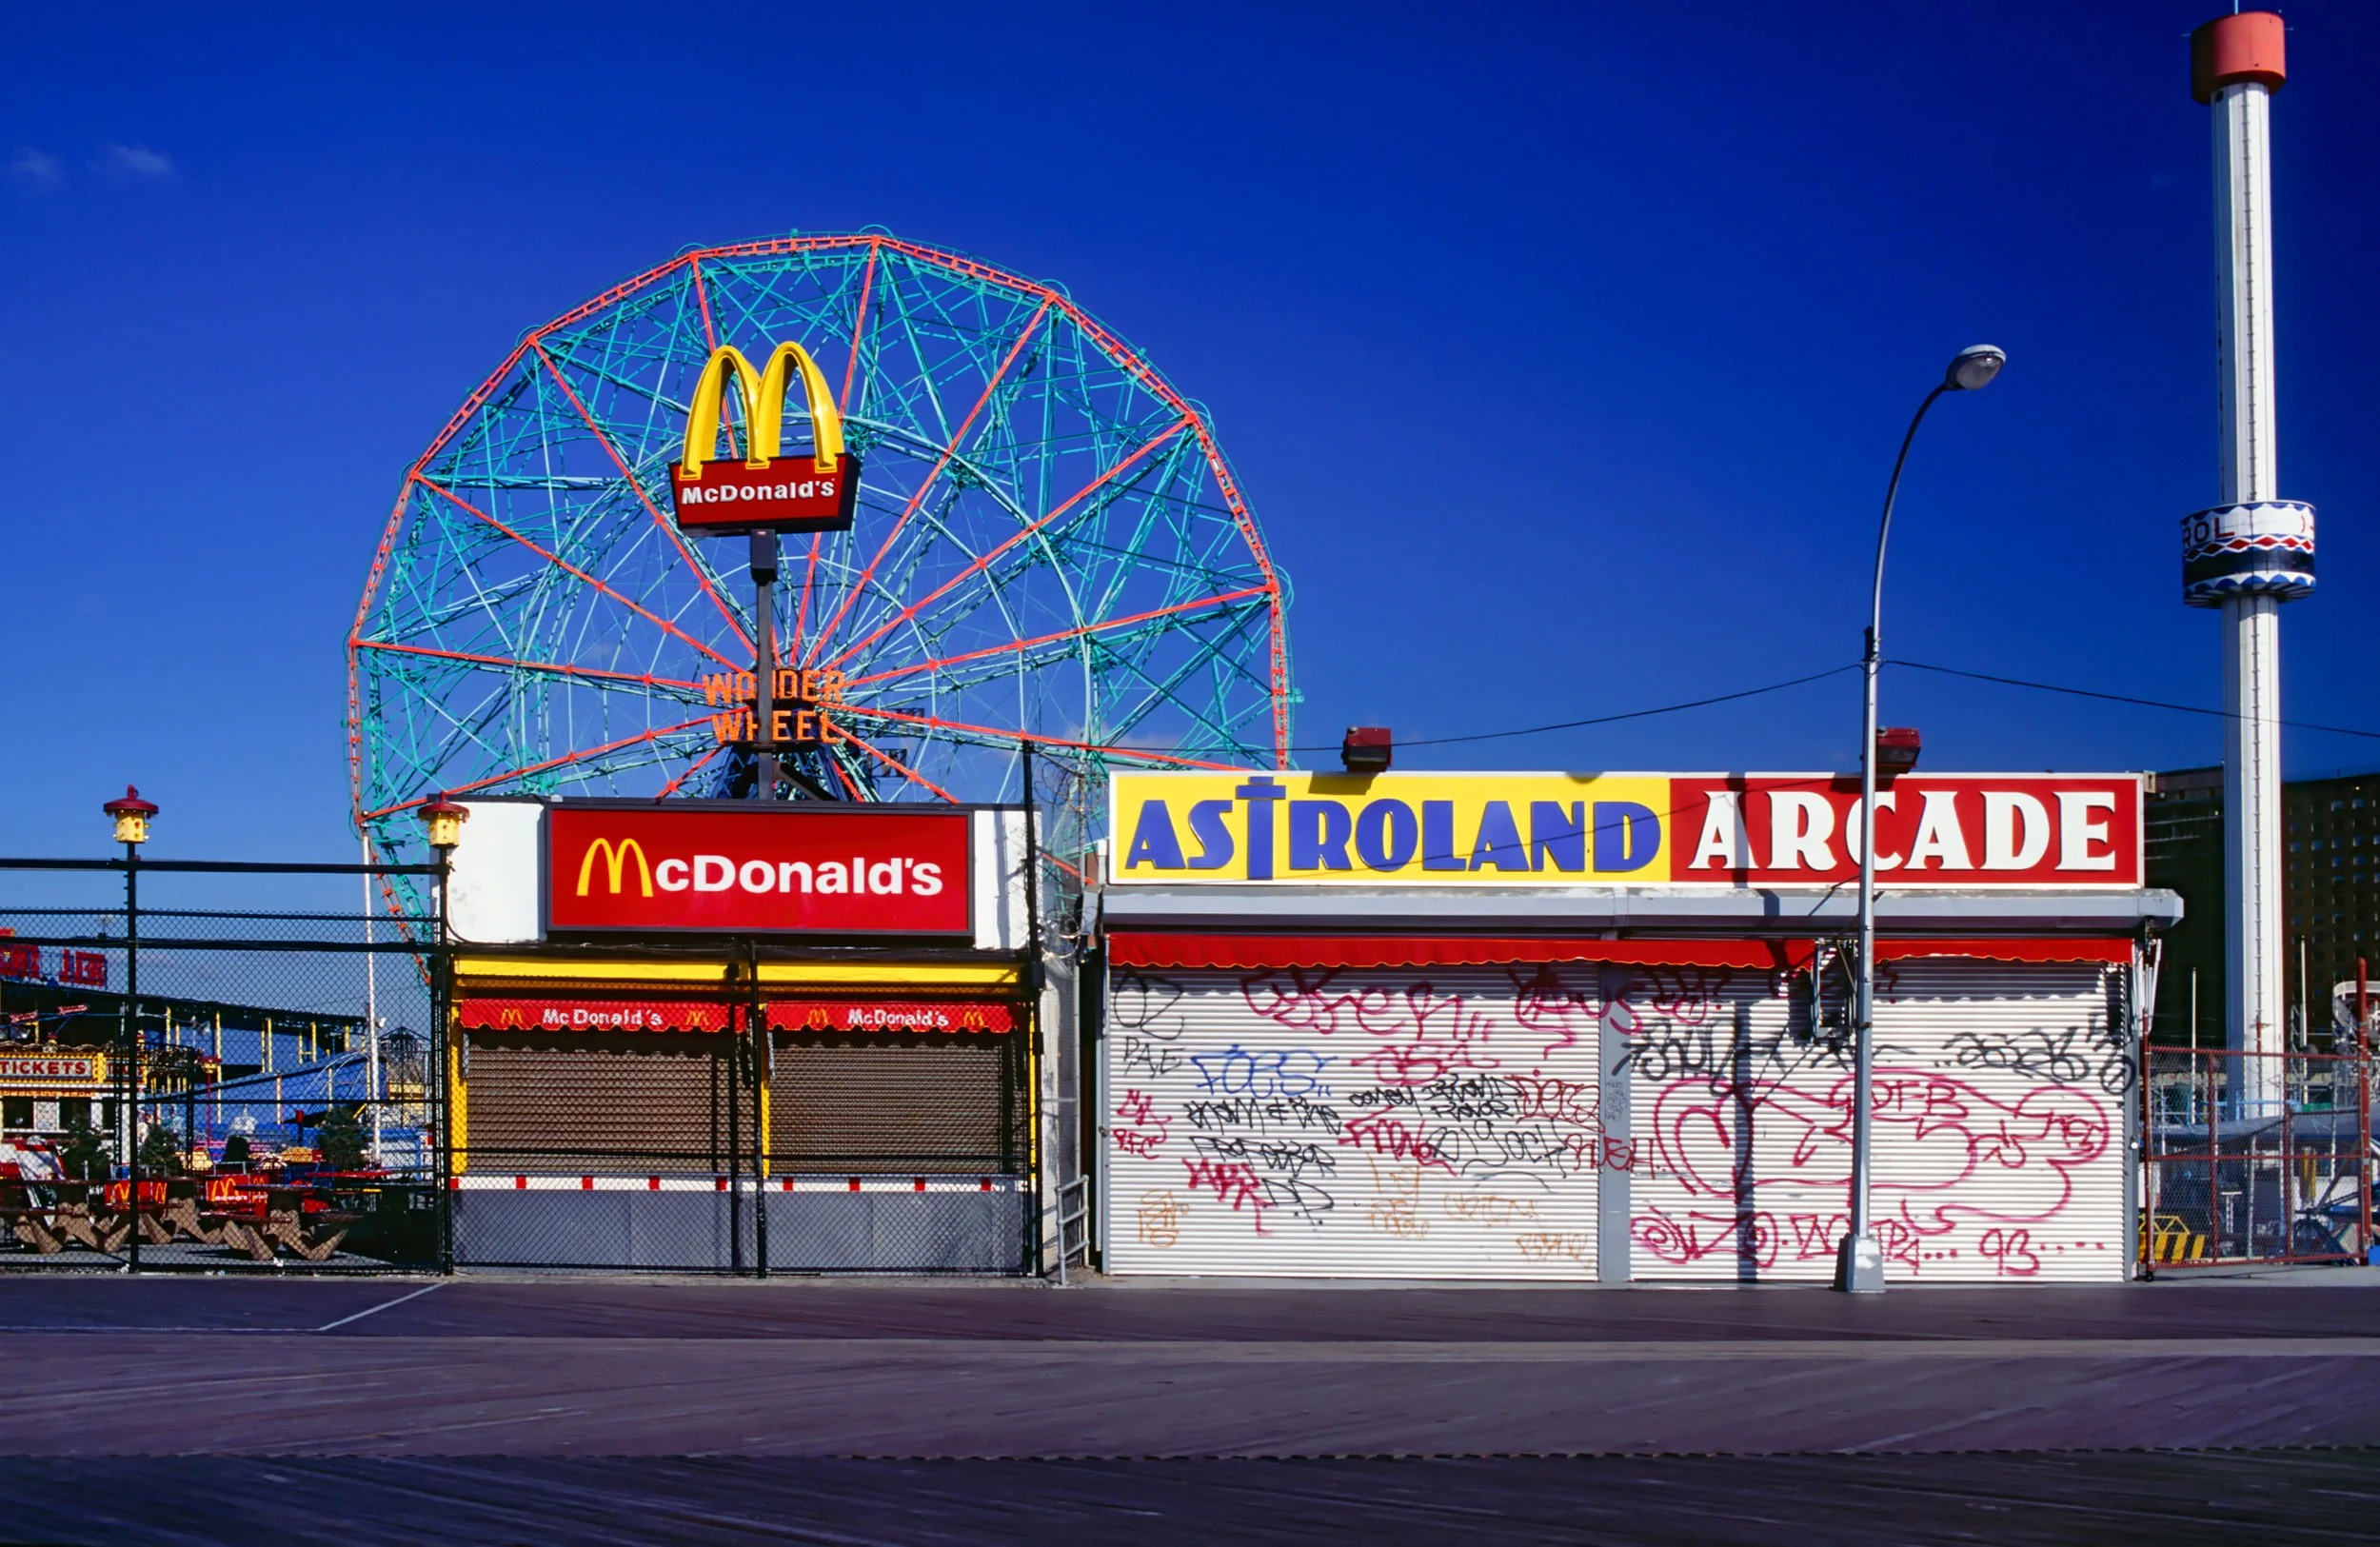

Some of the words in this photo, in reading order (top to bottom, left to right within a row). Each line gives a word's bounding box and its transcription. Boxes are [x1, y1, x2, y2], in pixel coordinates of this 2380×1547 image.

[682, 480, 835, 505] McDonald's
[703, 669, 845, 706] WODER
[1124, 776, 1661, 881] ASTROLAND
[1687, 791, 2115, 871] ARCADE
[576, 838, 942, 898] McDonald's
[543, 1008, 663, 1026] McDonald's
[847, 1009, 949, 1027] McDonald's
[0, 1061, 87, 1075] TICKETS
